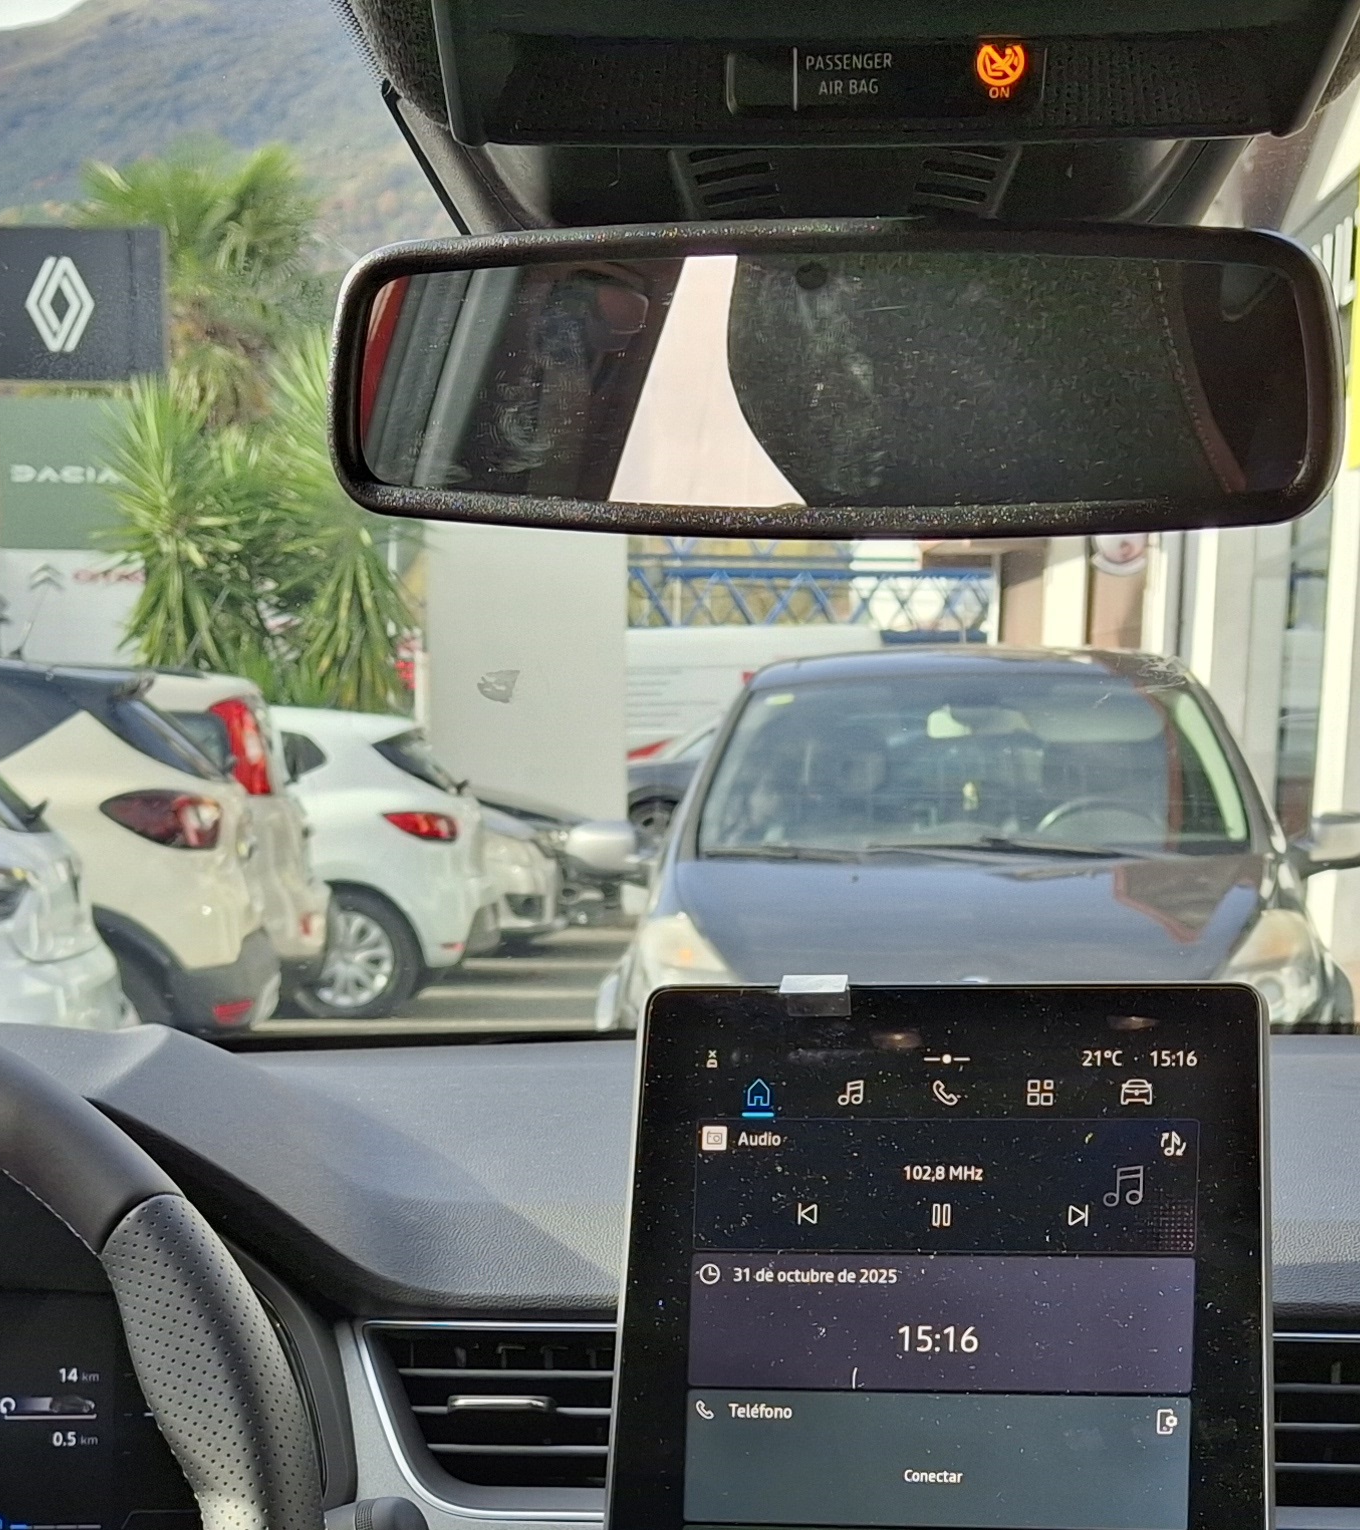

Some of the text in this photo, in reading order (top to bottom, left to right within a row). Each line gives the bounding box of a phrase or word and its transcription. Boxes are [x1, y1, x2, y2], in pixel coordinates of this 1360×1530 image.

[806, 52, 892, 71] PASSENGER
[818, 78, 879, 96] AIR BAG
[988, 86, 1010, 99] ON
[10, 463, 122, 483] DACIA
[1081, 1049, 1199, 1067] 21°C 15:16
[737, 1130, 782, 1148] Audio
[903, 1165, 983, 1182] 102,8 MHz
[732, 1267, 898, 1284] 31 de octubre de 2025
[897, 1325, 979, 1353] 15:16
[58, 1367, 100, 1383] 14 km
[728, 1402, 793, 1420] Teléfono
[52, 1432, 99, 1447] 0.5 km
[904, 1468, 963, 1485] Conectar
